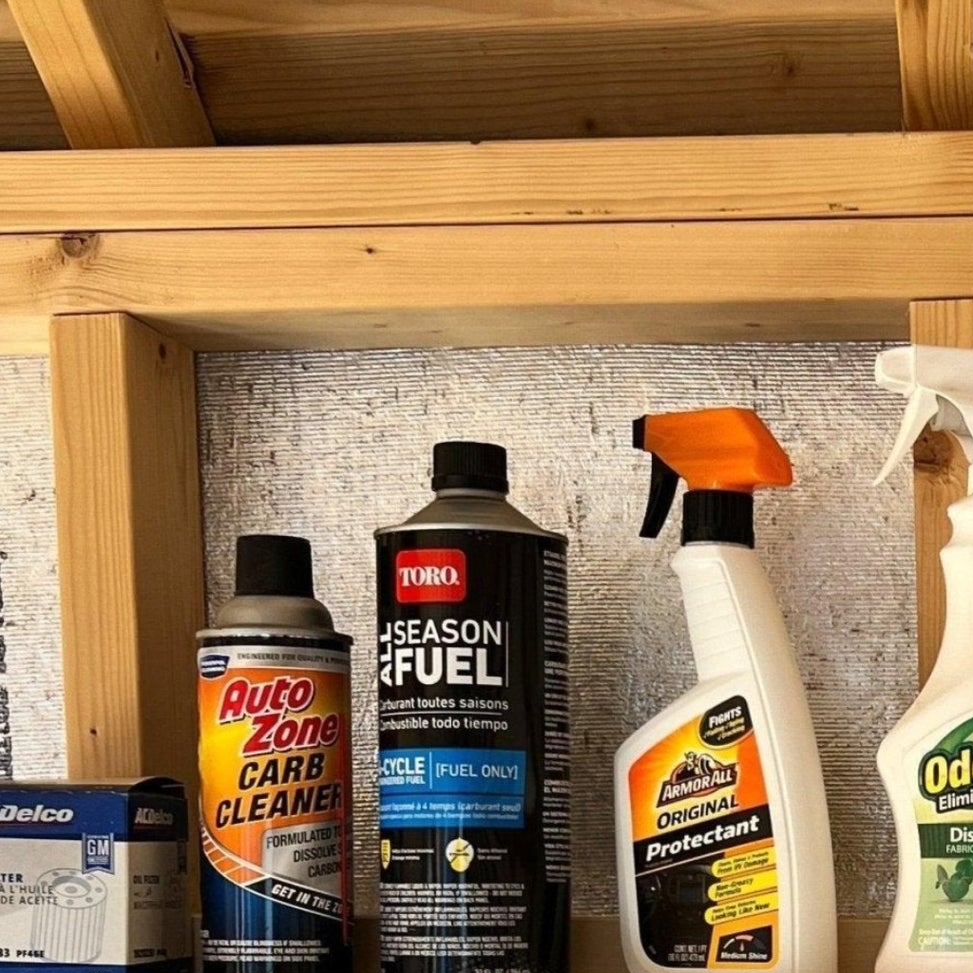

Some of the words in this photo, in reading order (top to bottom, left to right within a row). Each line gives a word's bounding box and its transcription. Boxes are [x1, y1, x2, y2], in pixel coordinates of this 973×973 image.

[399, 566, 459, 587] TORO
[393, 619, 502, 645] SEASON
[282, 653, 296, 662] FOR
[379, 622, 392, 687] ALL
[395, 646, 503, 686] FUEL
[217, 676, 315, 725] Auto
[417, 696, 456, 708] toutes
[459, 697, 509, 711] saisons
[432, 716, 461, 729] todo
[464, 717, 509, 733] tiempo
[709, 706, 742, 728] FIGHTS
[241, 712, 340, 757] Zone
[238, 752, 326, 790] CARB
[405, 776, 426, 785] FUEL
[135, 807, 173, 825] ACDelco
[656, 795, 739, 829] ORIGINAL
[87, 840, 109, 855] GM
[266, 828, 331, 849] FORMULATED
[646, 815, 760, 861] Protectant
[19, 896, 57, 906] ACEITE
[271, 884, 295, 899] GET
[296, 891, 309, 904] IN
[313, 896, 331, 911] THE
[720, 952, 746, 960] Medium
[748, 952, 768, 960] Shine
